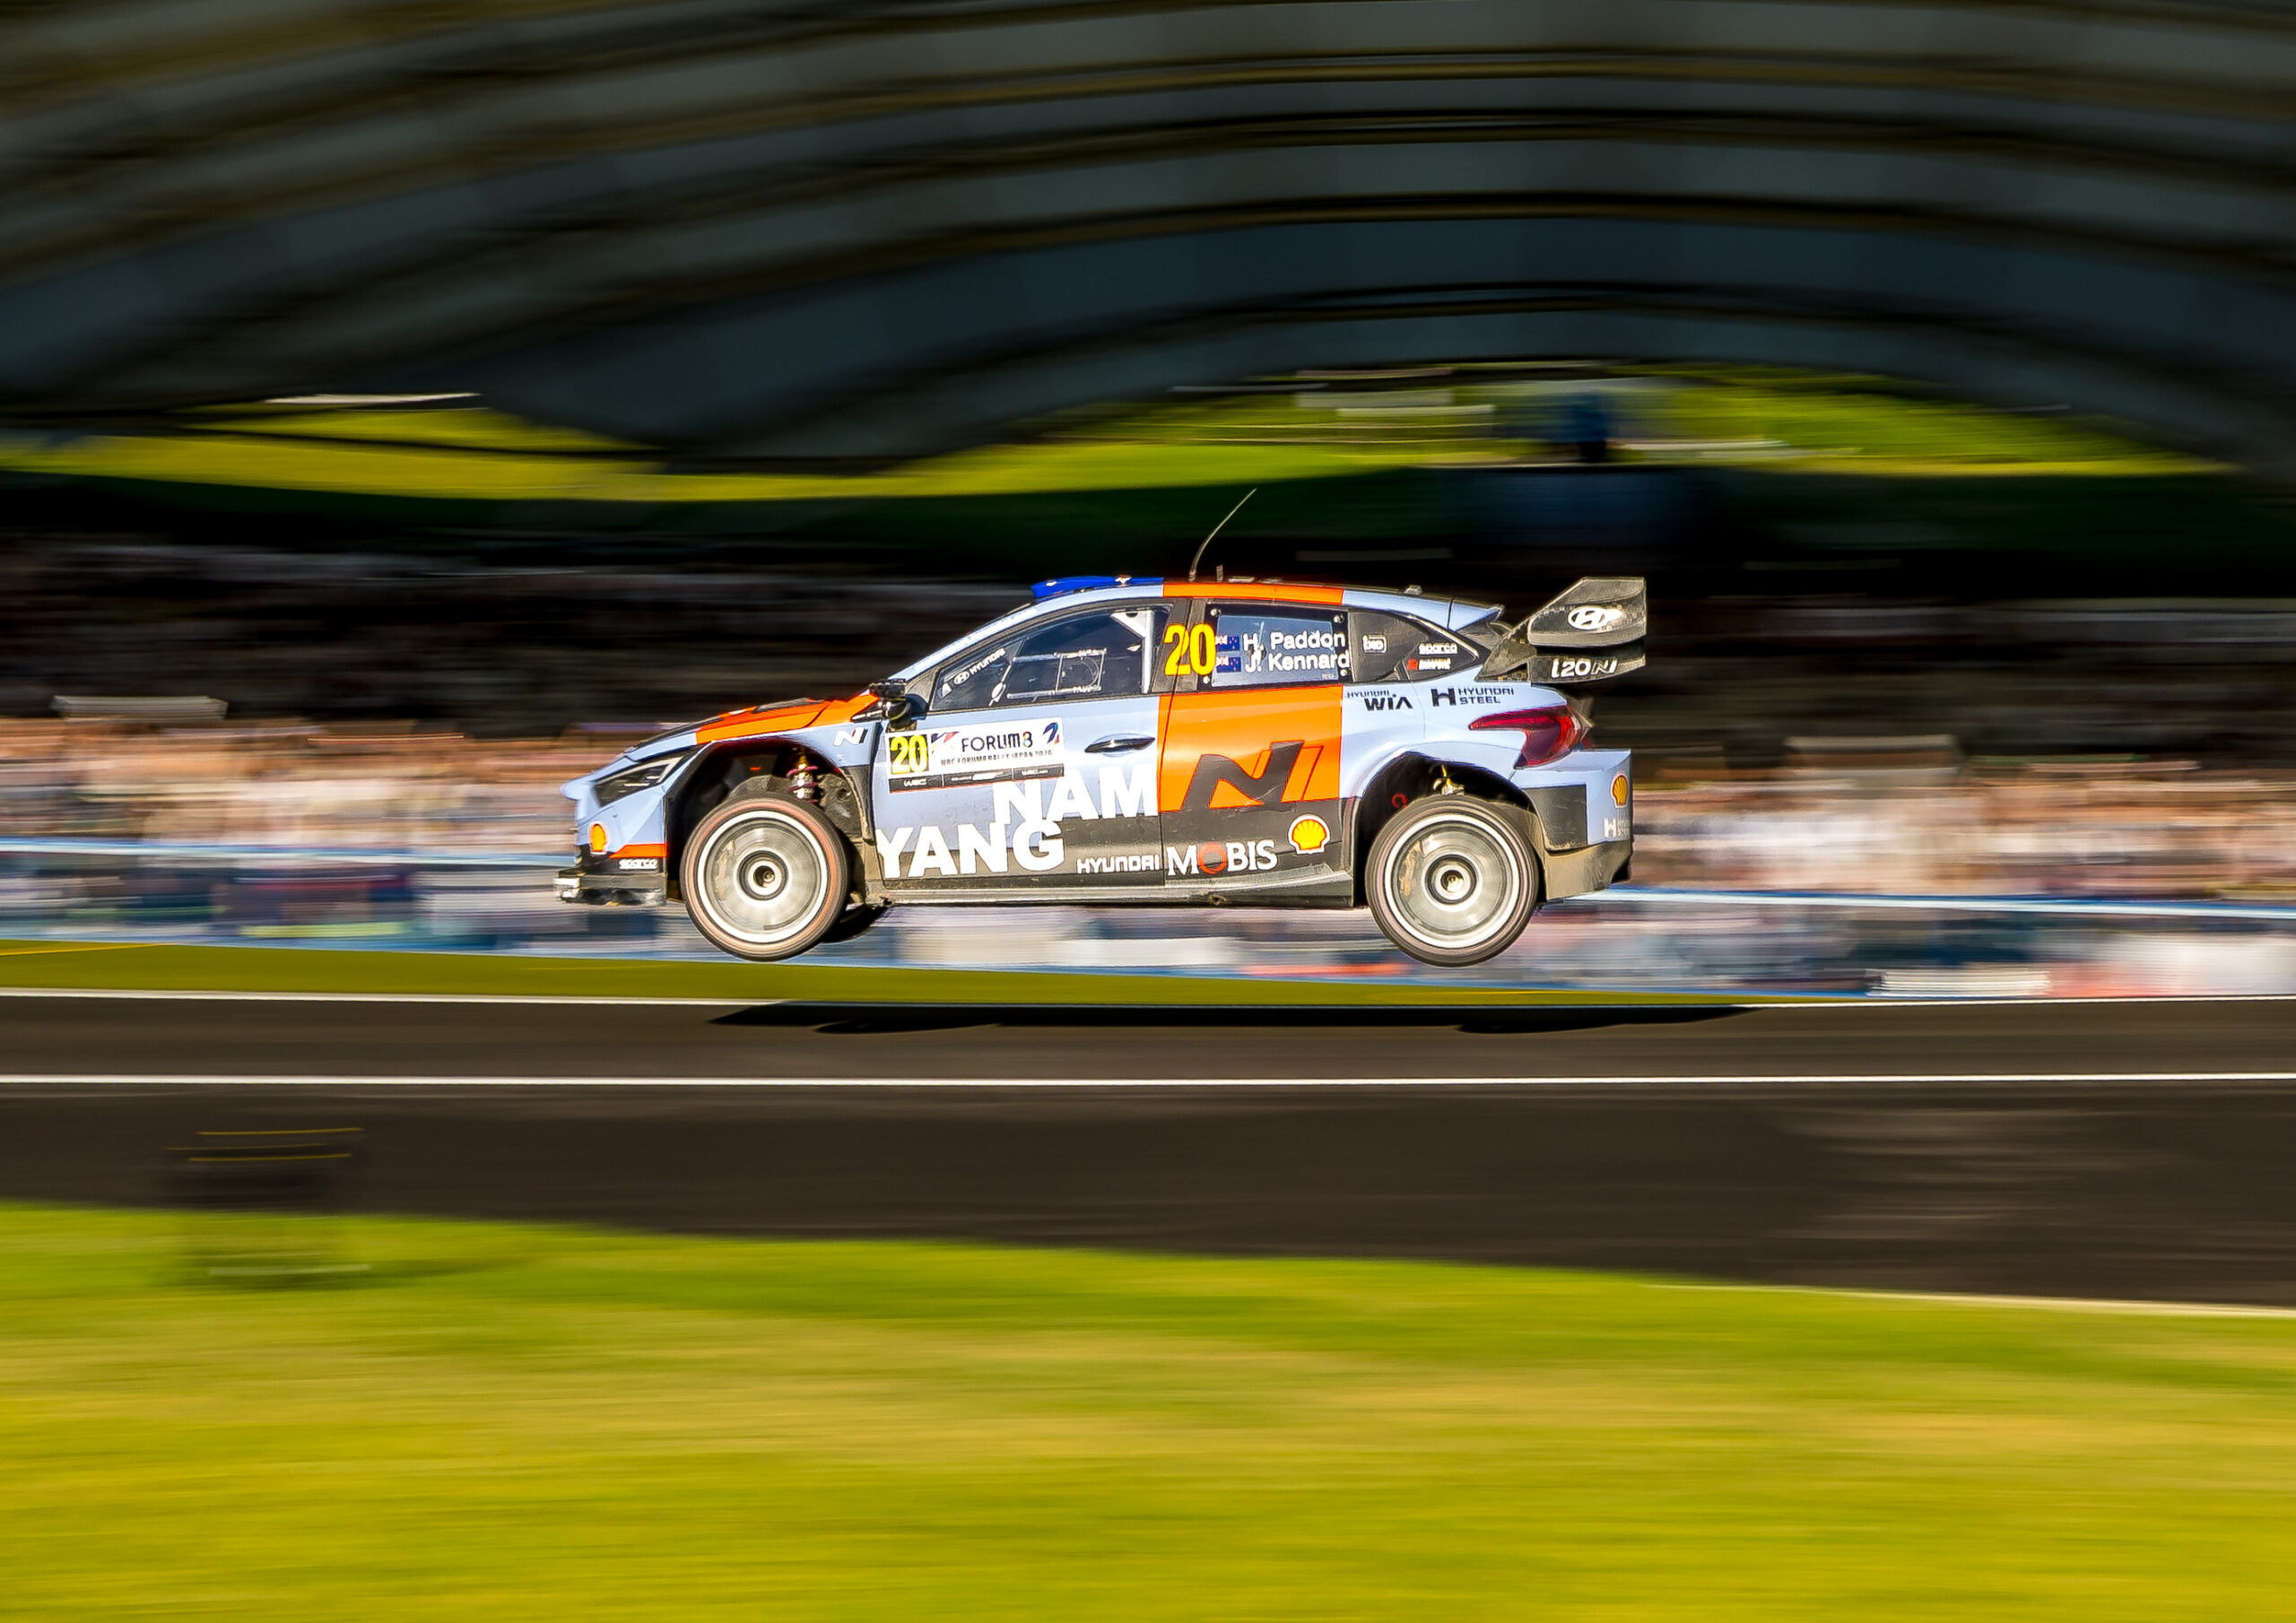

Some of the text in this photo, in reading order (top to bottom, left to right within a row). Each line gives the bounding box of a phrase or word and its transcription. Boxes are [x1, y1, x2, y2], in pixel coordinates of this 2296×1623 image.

[1163, 622, 1216, 675] 20
[1242, 632, 1265, 652] H.
[1270, 629, 1346, 651] Paddon
[970, 647, 1005, 675] HYUNDAI
[1245, 649, 1350, 673] J. Kennard
[1346, 690, 1390, 699] HYUNDAI
[1457, 687, 1515, 696] HYUNDAI
[1459, 695, 1501, 705] STEEL
[961, 731, 1033, 752] FORUM8
[889, 734, 929, 775] 20
[992, 765, 1158, 824] NAM
[875, 819, 1065, 879] YANG
[1166, 840, 1278, 876] MOBIS
[1076, 854, 1161, 875] HYUNDAI
